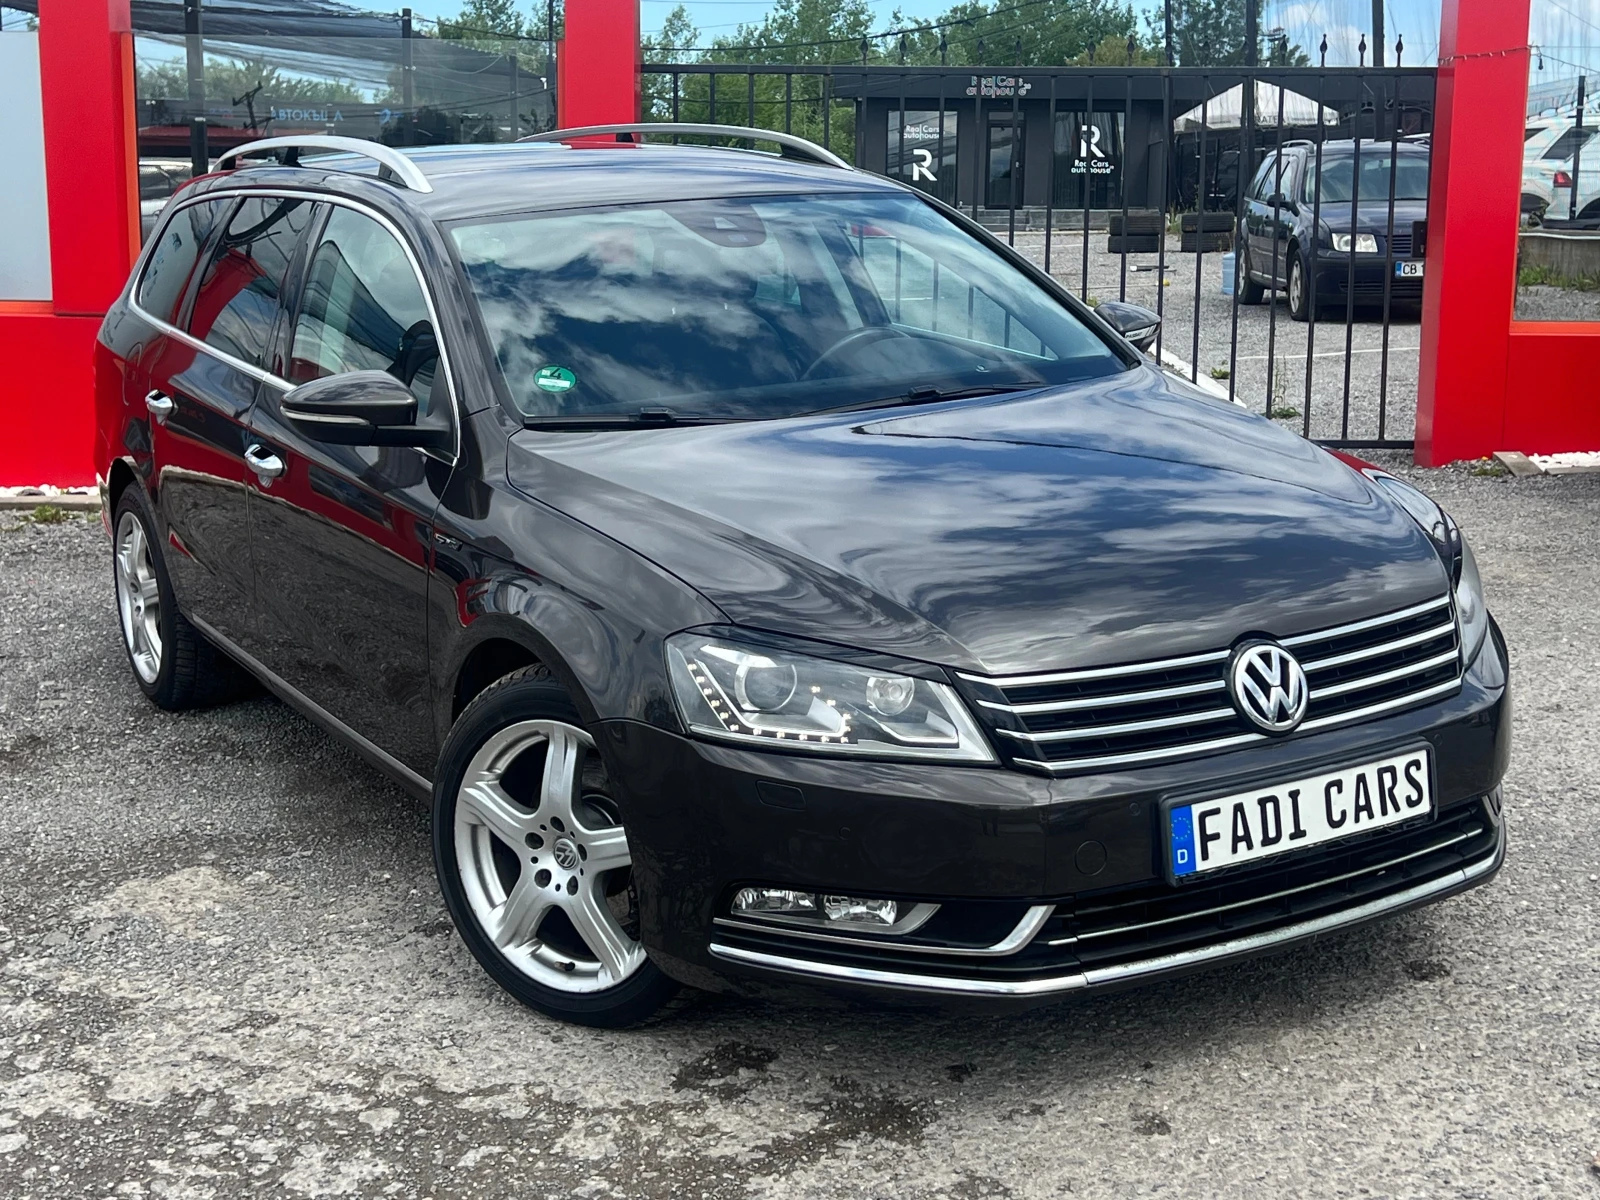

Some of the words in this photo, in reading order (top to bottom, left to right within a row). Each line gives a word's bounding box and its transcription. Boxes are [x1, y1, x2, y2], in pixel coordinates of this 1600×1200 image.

[996, 76, 1023, 87] Cas
[912, 148, 938, 181] R
[1090, 159, 1109, 168] Cars
[550, 367, 562, 380] 4
[1234, 645, 1309, 731] VW
[1177, 848, 1189, 865] D
[1198, 788, 1307, 862] FADI
[1324, 758, 1424, 830] CARS
